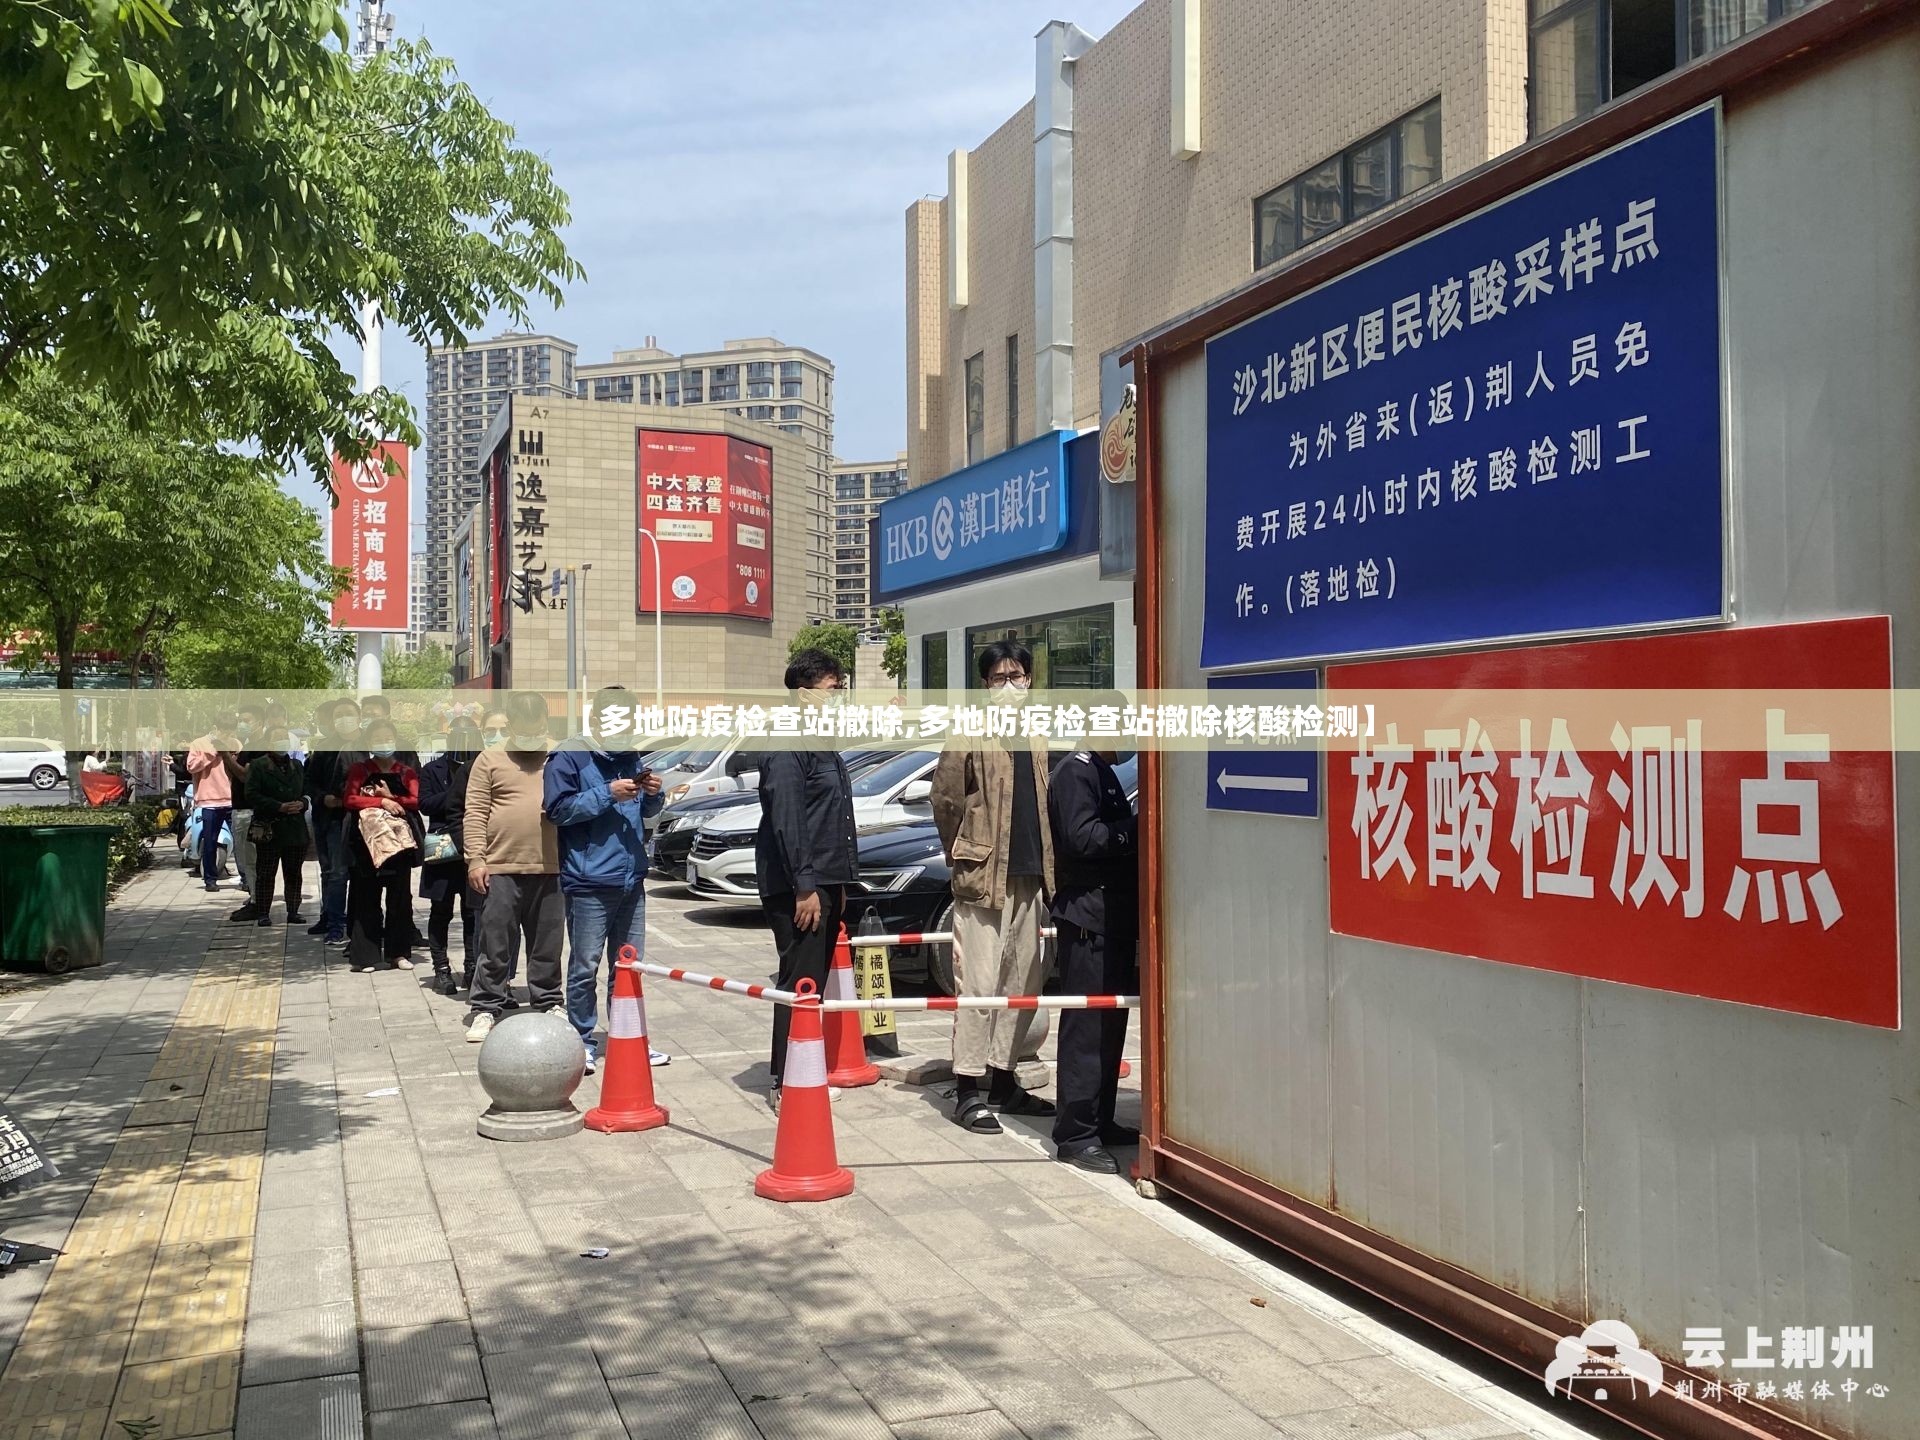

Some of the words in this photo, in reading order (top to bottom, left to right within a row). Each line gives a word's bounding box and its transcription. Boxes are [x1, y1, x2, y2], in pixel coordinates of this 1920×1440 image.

[1232, 197, 1660, 416] 沙北新区便民核酸采样点
[530, 406, 549, 419] A7
[646, 472, 723, 493] 中大豪盛
[646, 494, 722, 514] 四盘齐售
[959, 466, 1051, 548] 漢口銀行
[1235, 414, 1651, 551] 费开展24小时内核酸检测工
[352, 498, 360, 527] CHINA
[362, 498, 388, 611] 招商銀行
[885, 515, 928, 565] HKB
[352, 585, 360, 610] BANK
[1350, 709, 1843, 930] 核酸检测点
